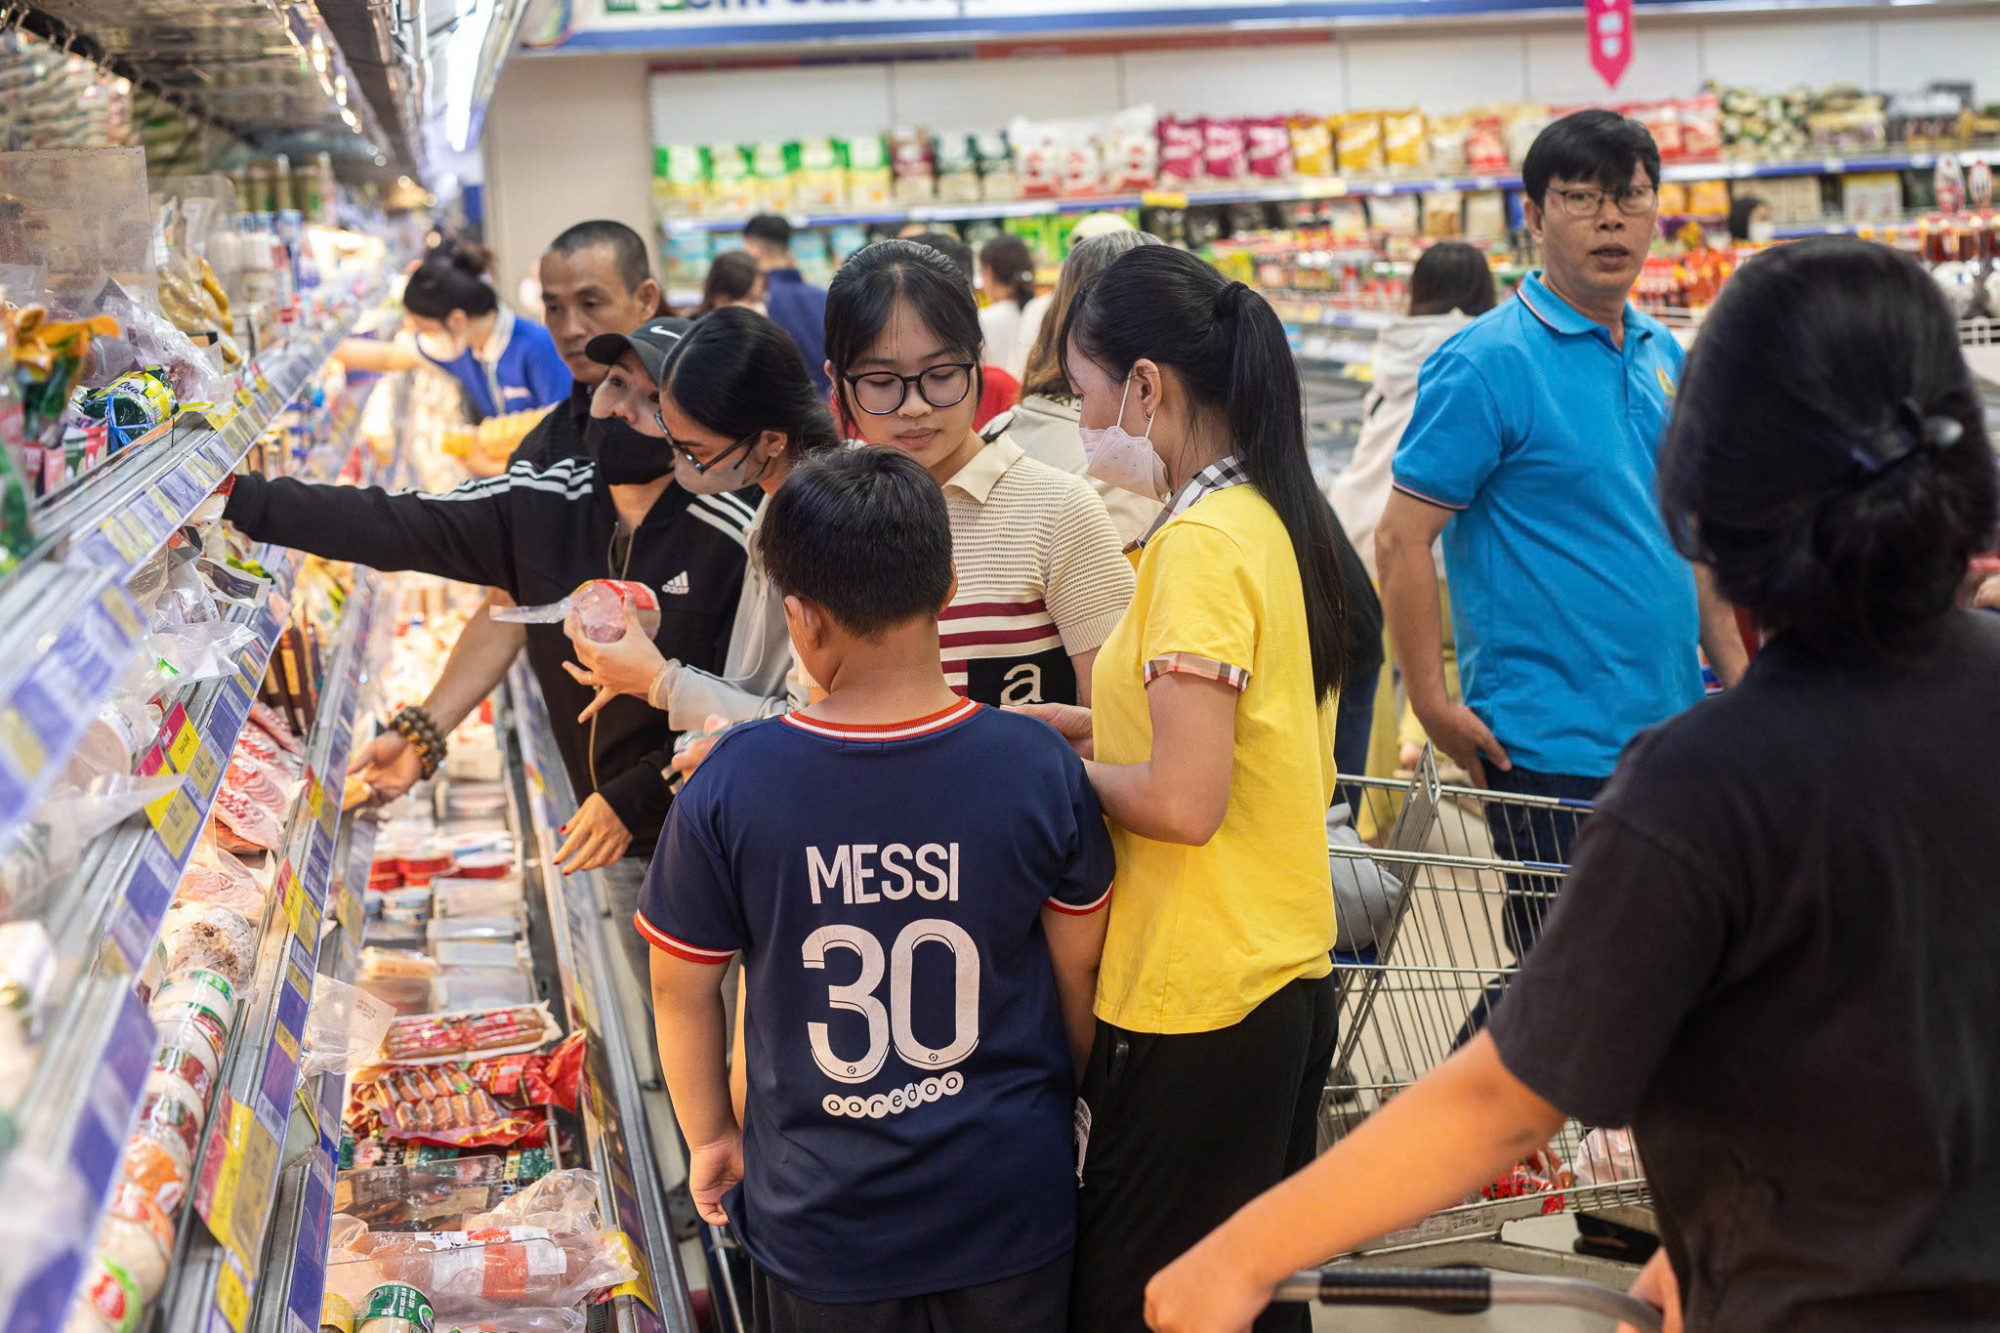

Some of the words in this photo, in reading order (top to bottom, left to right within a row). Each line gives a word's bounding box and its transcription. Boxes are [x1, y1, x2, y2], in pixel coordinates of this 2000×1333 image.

[1000, 662, 1045, 706] a
[806, 842, 960, 905] MESSI
[801, 918, 981, 1084] 30
[822, 1071, 964, 1118] ooredoo
